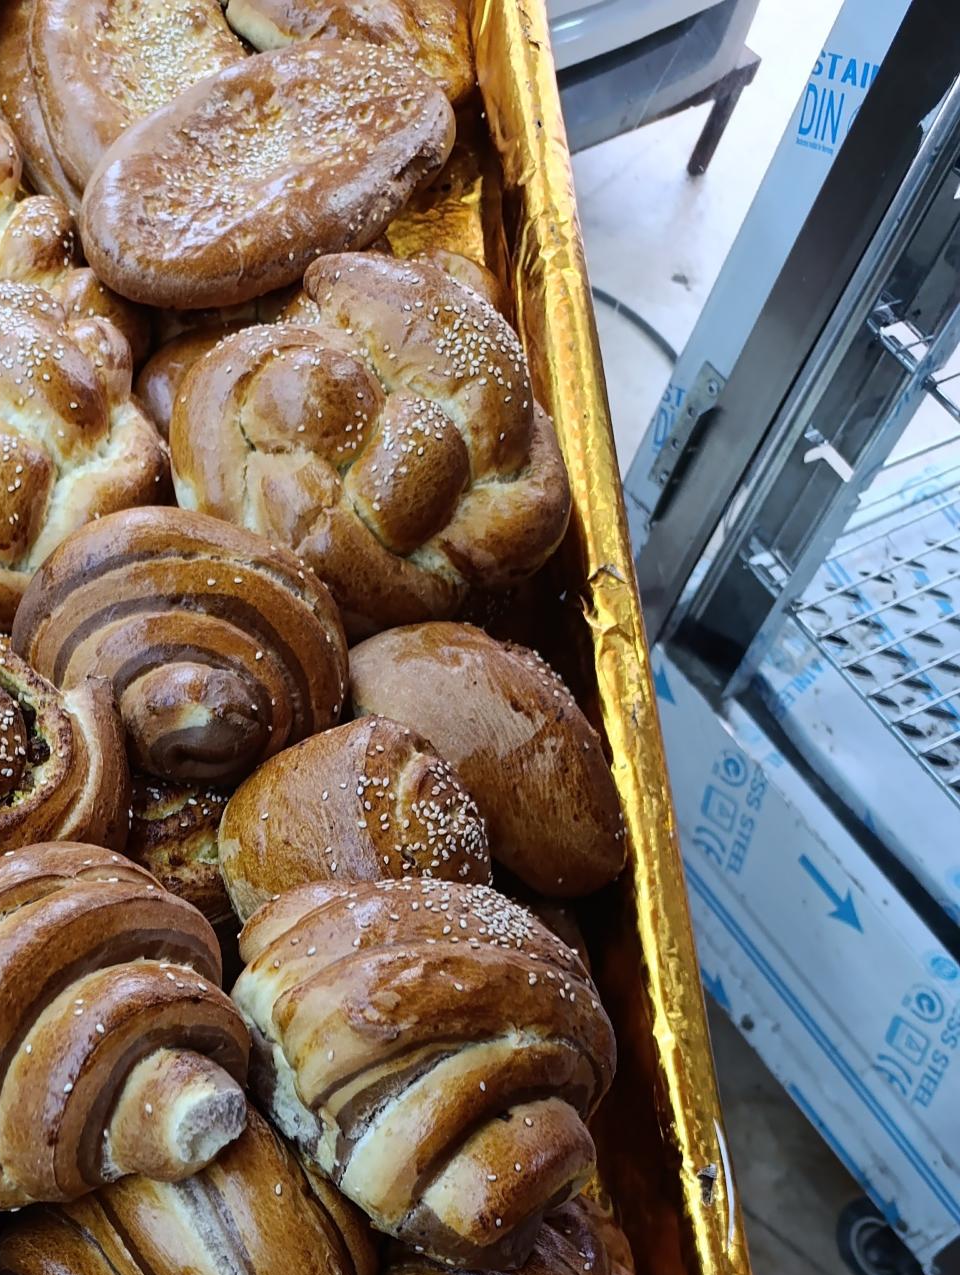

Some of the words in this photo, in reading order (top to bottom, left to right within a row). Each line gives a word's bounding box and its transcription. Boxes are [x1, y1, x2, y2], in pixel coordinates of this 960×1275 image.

[812, 50, 880, 88] STAI
[798, 82, 845, 145] DIN
[724, 814, 754, 875] STEEL
[914, 1048, 949, 1108] STEEL
